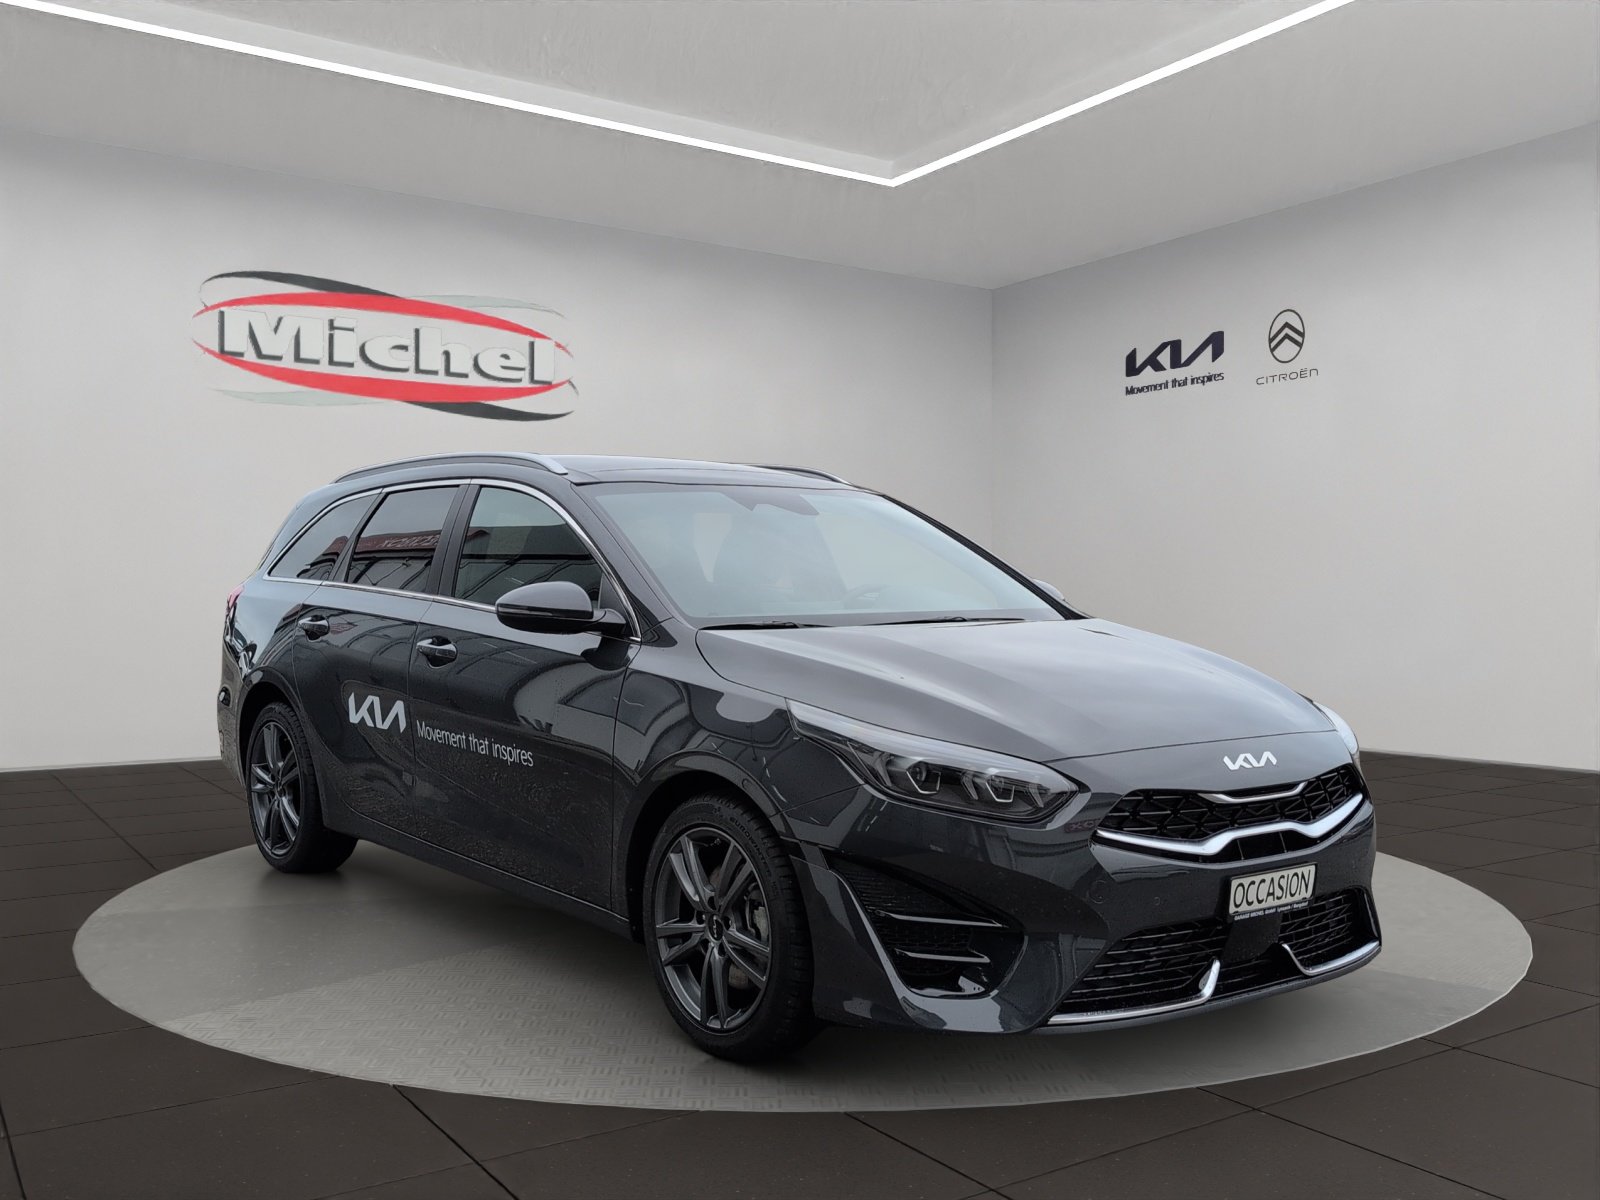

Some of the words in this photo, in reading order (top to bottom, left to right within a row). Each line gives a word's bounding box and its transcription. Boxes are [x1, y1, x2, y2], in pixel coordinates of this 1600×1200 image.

[217, 308, 555, 385] Michel
[1125, 331, 1224, 377] KIA
[1125, 380, 1169, 396] Movement
[1171, 376, 1188, 389] that
[1190, 372, 1225, 386] inspires
[348, 692, 407, 733] KIA
[416, 720, 466, 750] Movement
[469, 733, 489, 755] that
[492, 740, 534, 767] inspires
[1233, 869, 1311, 908] OCCASION
